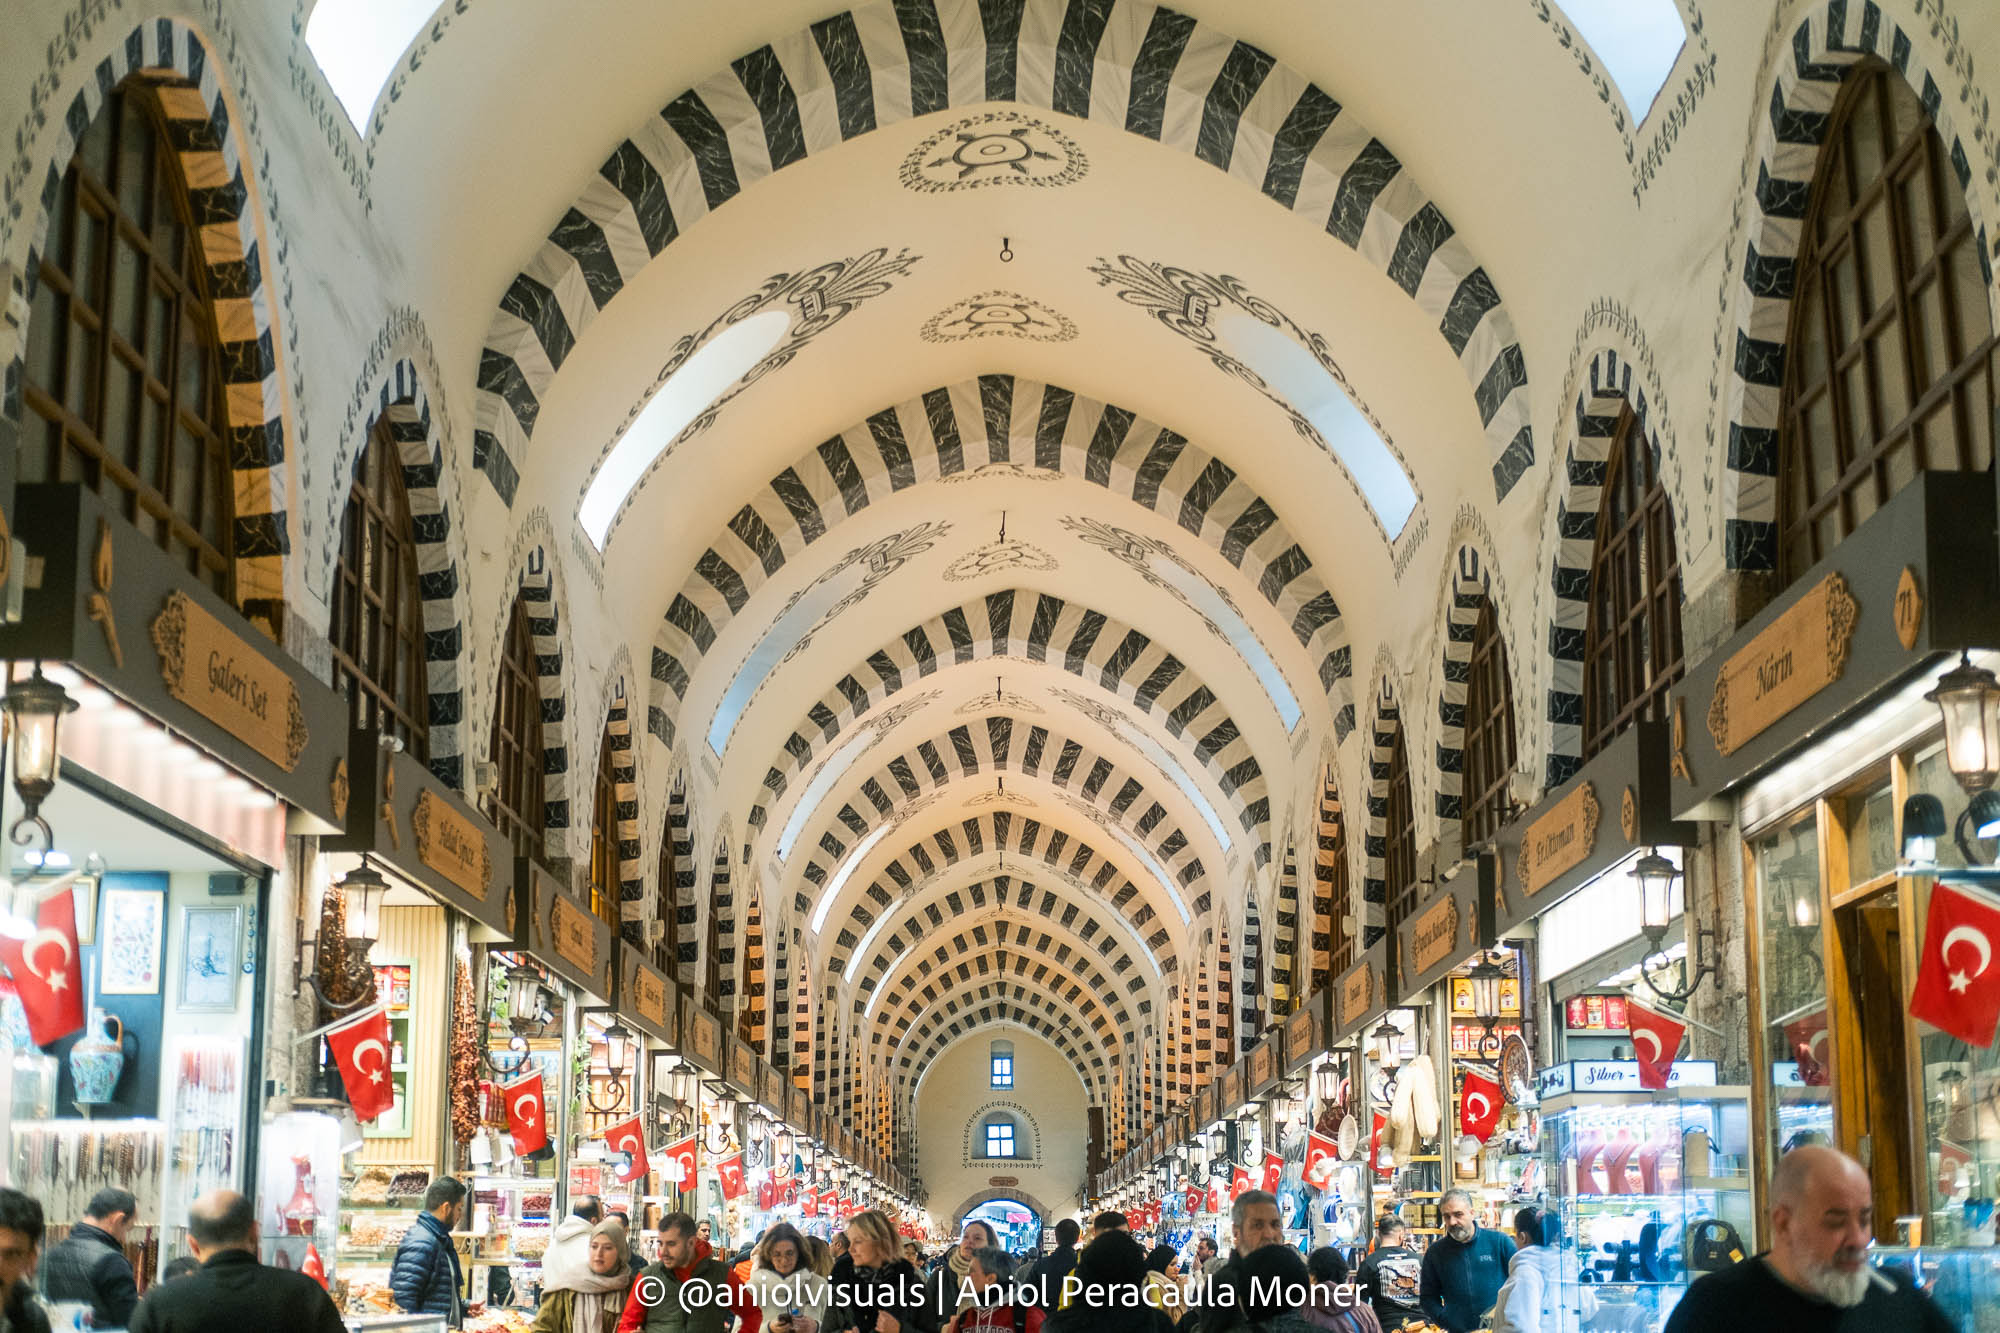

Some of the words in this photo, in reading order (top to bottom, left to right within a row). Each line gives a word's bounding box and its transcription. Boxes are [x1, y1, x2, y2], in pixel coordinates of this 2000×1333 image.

[1899, 588, 1912, 630] 71
[208, 649, 248, 706] Galeri
[249, 681, 268, 721] Set
[1584, 1066, 1625, 1085] Silver
